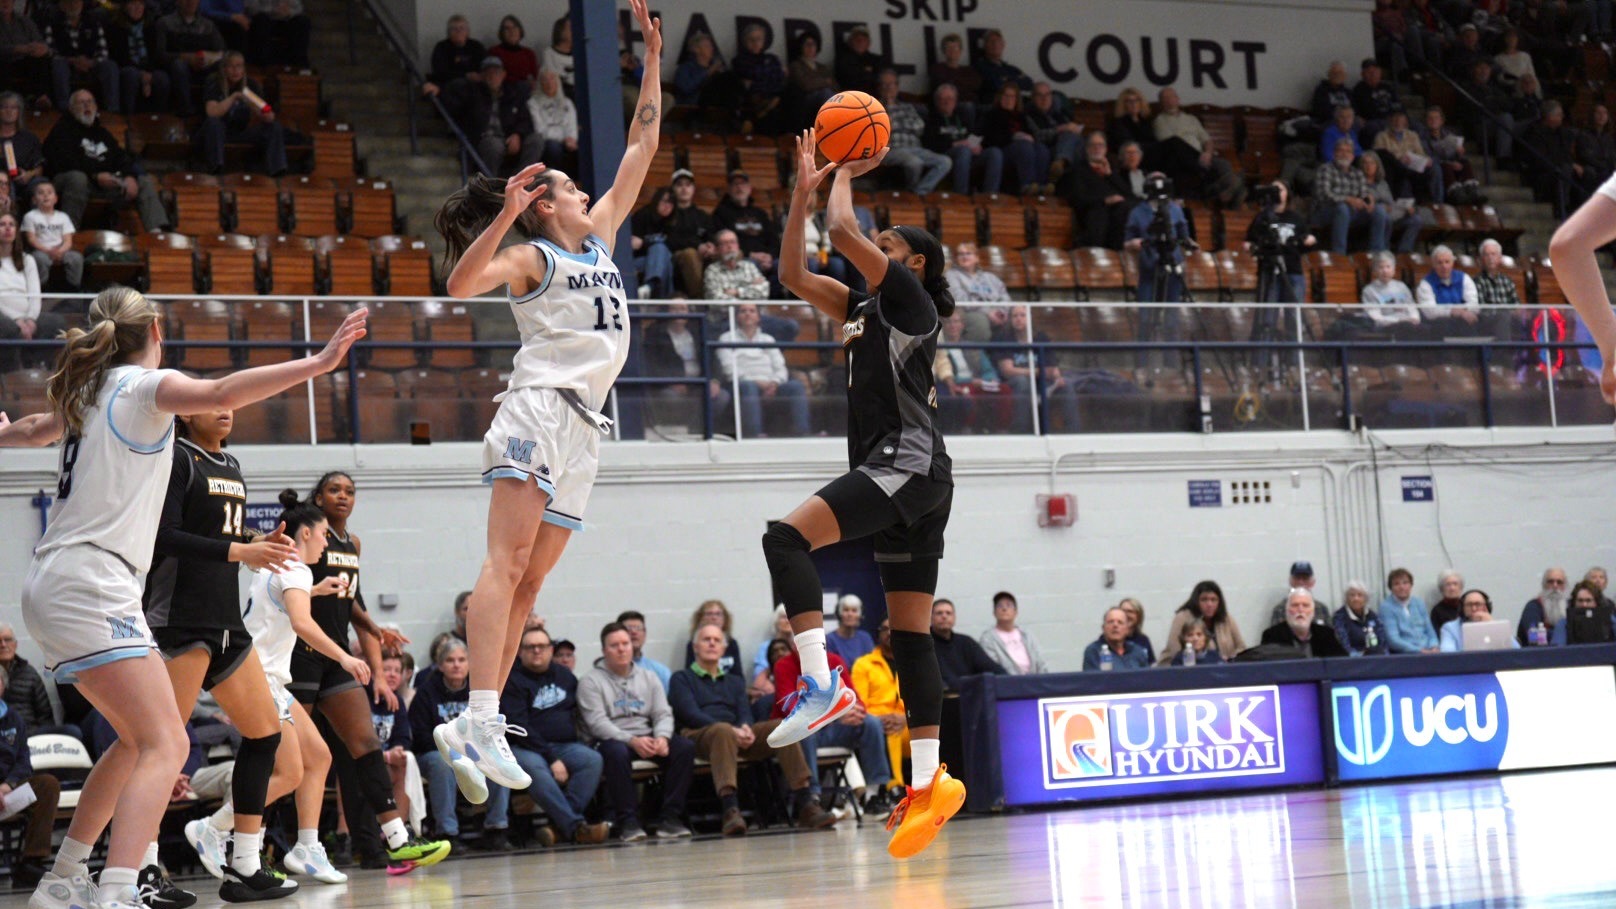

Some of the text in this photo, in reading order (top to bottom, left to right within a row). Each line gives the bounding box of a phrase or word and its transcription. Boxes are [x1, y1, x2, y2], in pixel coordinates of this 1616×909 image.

[885, 0, 979, 22] SKIP
[1037, 31, 1267, 90] COURT
[503, 436, 537, 464] M
[222, 501, 242, 536] 14
[106, 616, 144, 640] M
[1400, 692, 1499, 747] UCU
[1115, 742, 1276, 777] HYUNDAI
